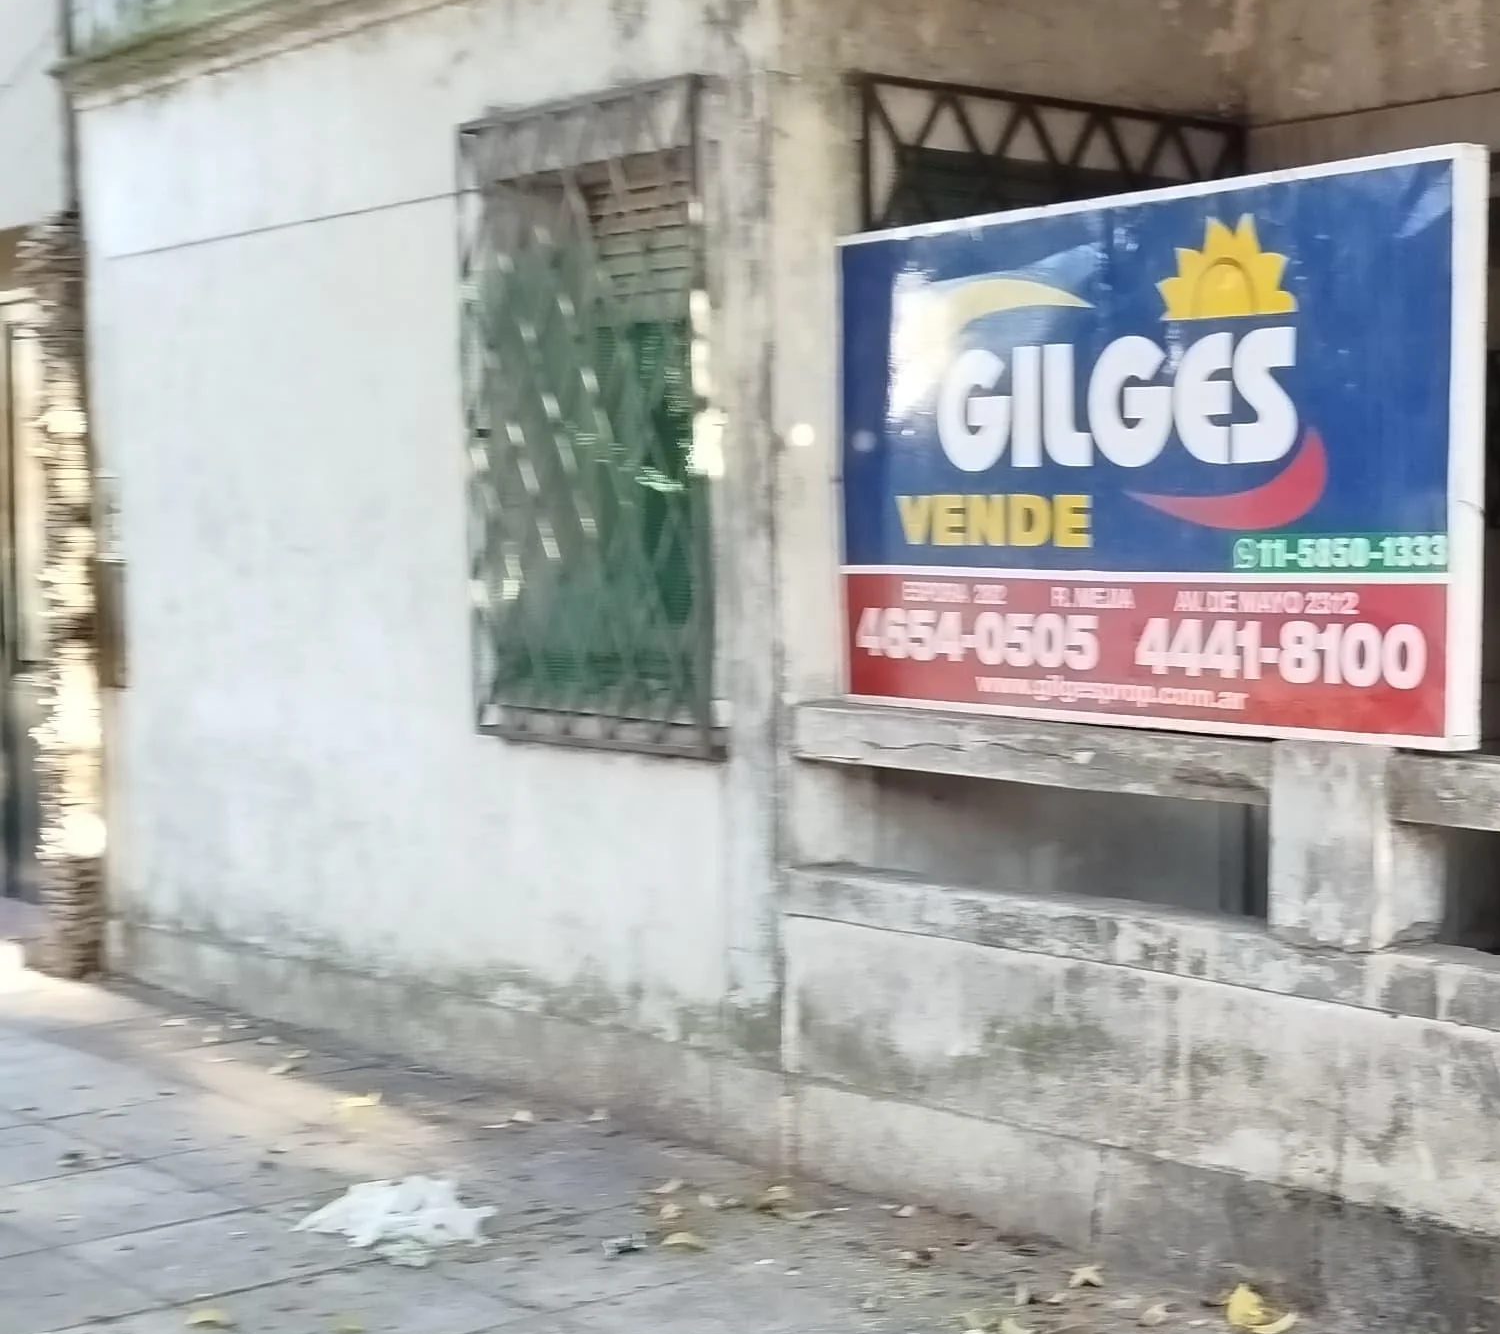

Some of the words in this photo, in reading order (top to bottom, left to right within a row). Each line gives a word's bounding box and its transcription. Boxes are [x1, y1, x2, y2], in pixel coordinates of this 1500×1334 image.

[936, 326, 1299, 472] GILGES
[895, 494, 1093, 548] VENDE
[856, 607, 1099, 670] 4654-0505
[1135, 617, 1428, 690] 4441-8100
